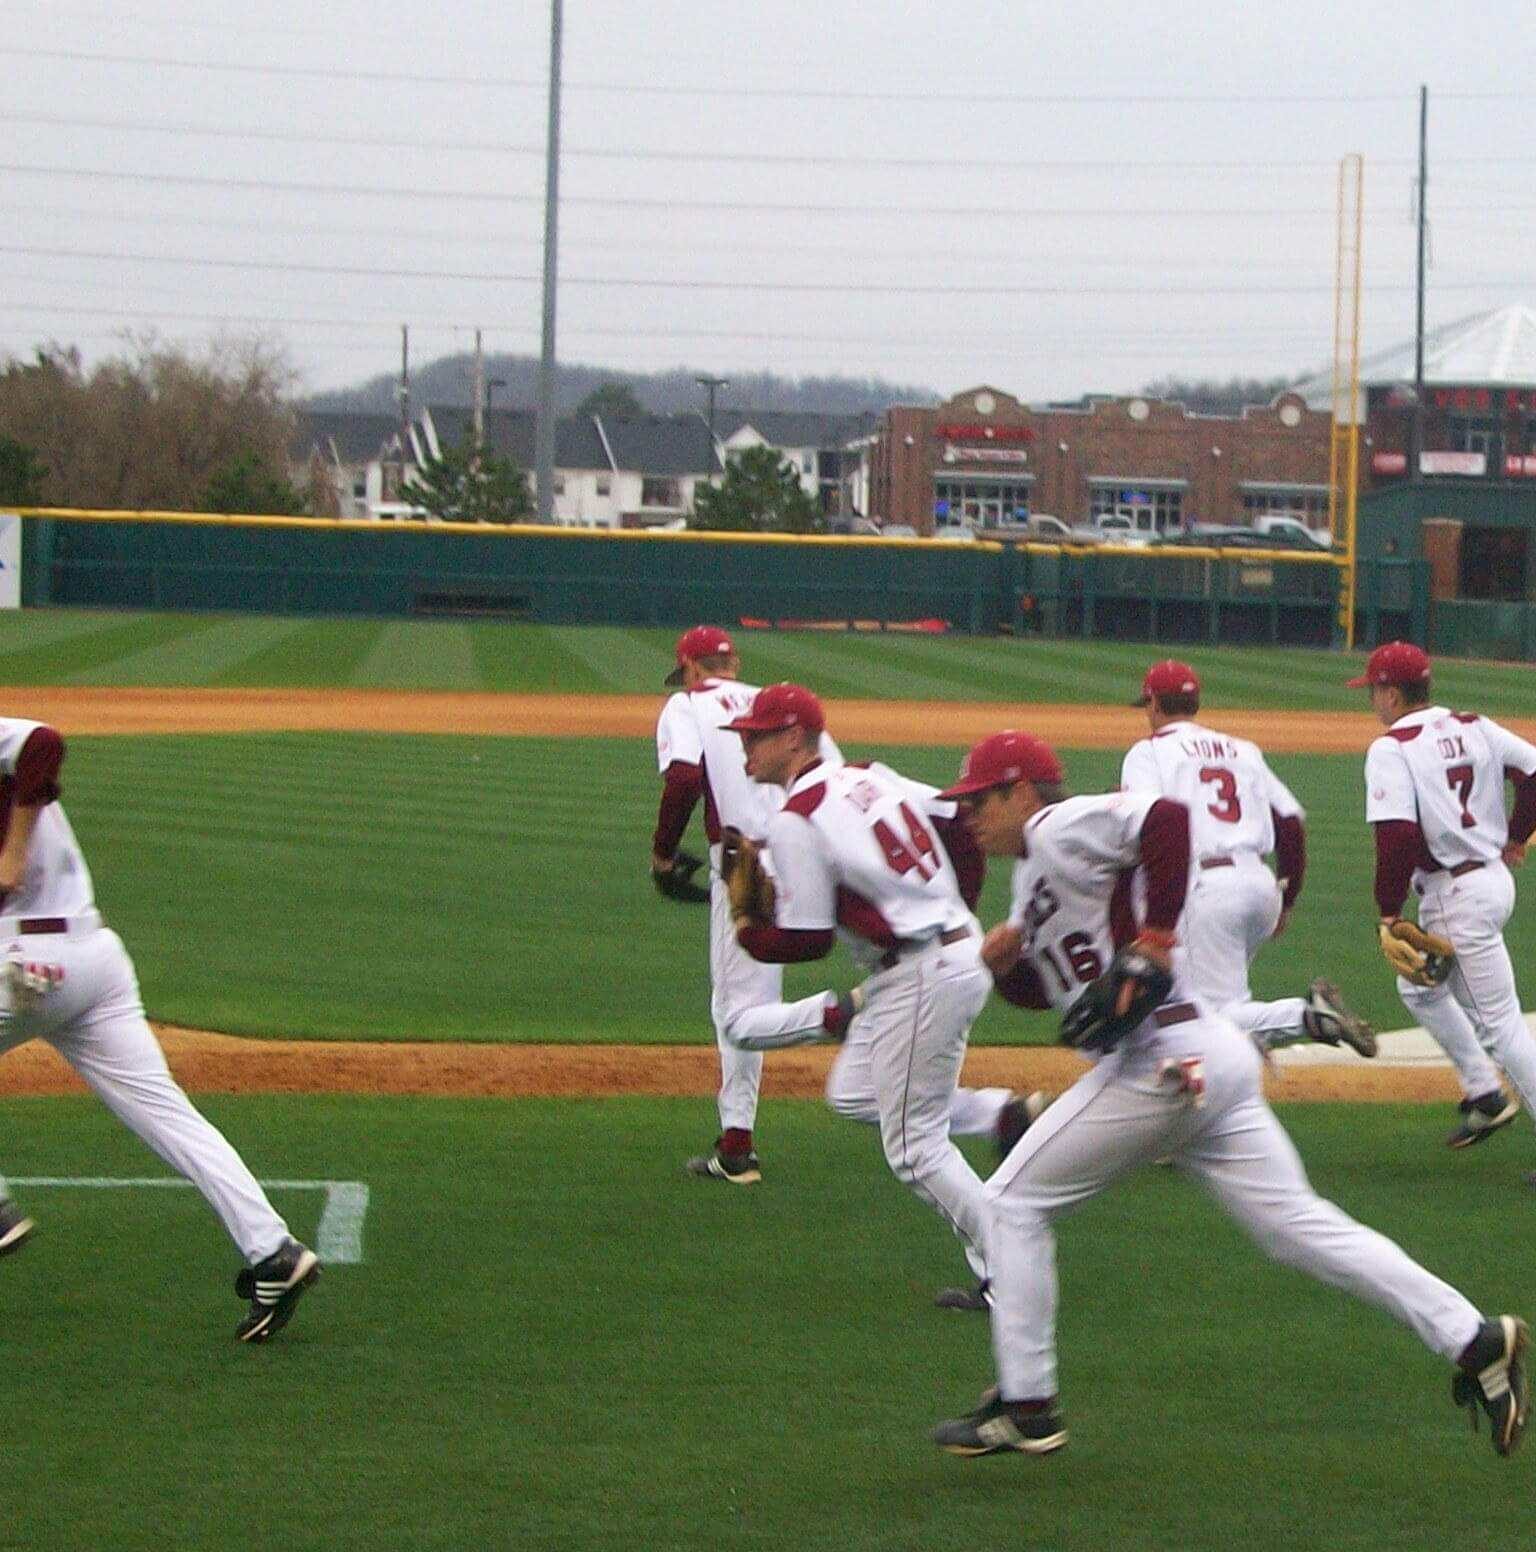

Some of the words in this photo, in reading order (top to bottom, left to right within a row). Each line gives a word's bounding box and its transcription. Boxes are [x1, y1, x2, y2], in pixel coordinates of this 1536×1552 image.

[1179, 739, 1238, 759] LYONS
[1199, 767, 1242, 824] 3
[1446, 765, 1477, 829] 7
[872, 800, 942, 882] 44
[1040, 931, 1103, 993] 16
